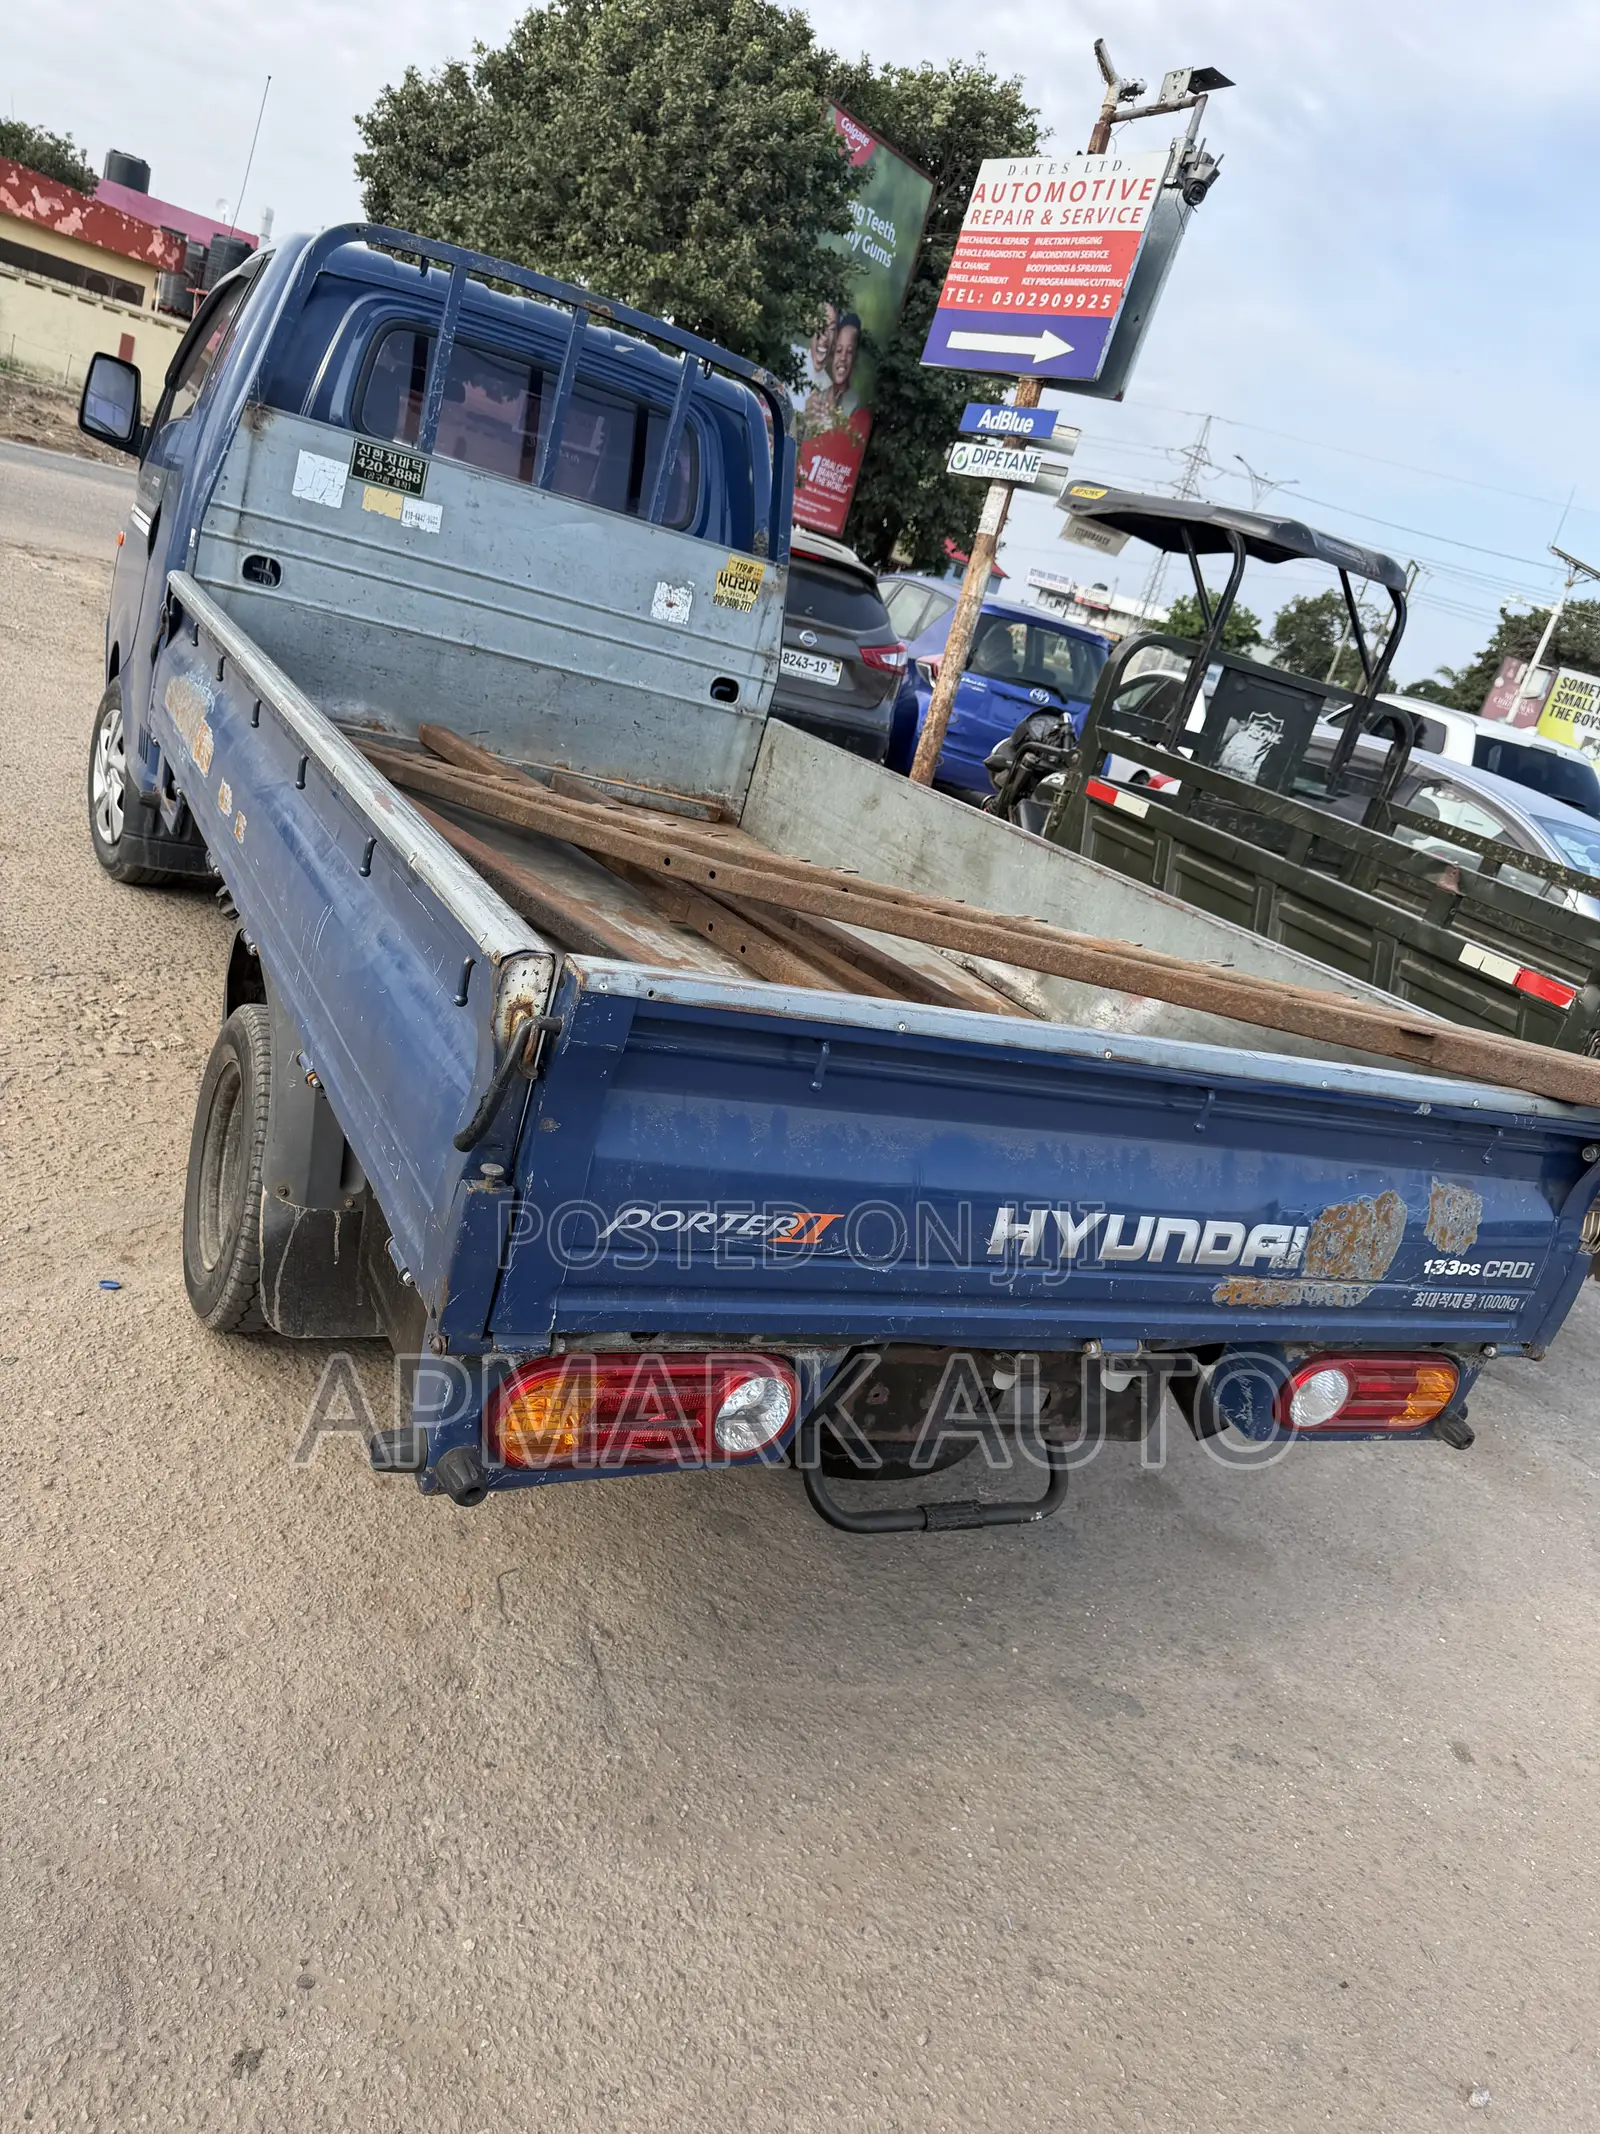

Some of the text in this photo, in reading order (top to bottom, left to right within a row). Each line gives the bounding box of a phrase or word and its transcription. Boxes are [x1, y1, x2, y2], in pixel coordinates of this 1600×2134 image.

[840, 117, 870, 147] Colgate
[1008, 159, 1132, 176] DATES LTD.
[972, 177, 1156, 203] AUTOMOTIVE
[970, 207, 1144, 225] REPAIR & SERVICE
[866, 207, 897, 248] Teeth,
[959, 236, 1030, 246] MECHANICAL REPAIRS
[1034, 236, 1071, 245] INJECTION
[955, 248, 1027, 259] VEHICLE DIAGNOSTICS
[1079, 250, 1110, 259] SERVICE
[962, 262, 991, 271] CHANGE
[1026, 264, 1112, 273] BODYWORKS & SPRAYING
[947, 273, 1009, 285] WHEEL ALIGNMENT
[1021, 277, 1036, 286] KEY
[946, 287, 1112, 309] TEL: 0302909925
[977, 408, 1035, 434] AdBlue
[971, 447, 1042, 473] DIPETANE
[356, 458, 422, 484] 420-2888
[967, 465, 1035, 483] FUEL TECHNOLOGY
[735, 562, 748, 573] 119
[1554, 691, 1593, 712] SMALL
[1548, 704, 1573, 722] THE
[597, 1206, 800, 1239] PORTER
[986, 1206, 1309, 1269] HYUNDAI
[1411, 1292, 1478, 1309] 최대적재량
